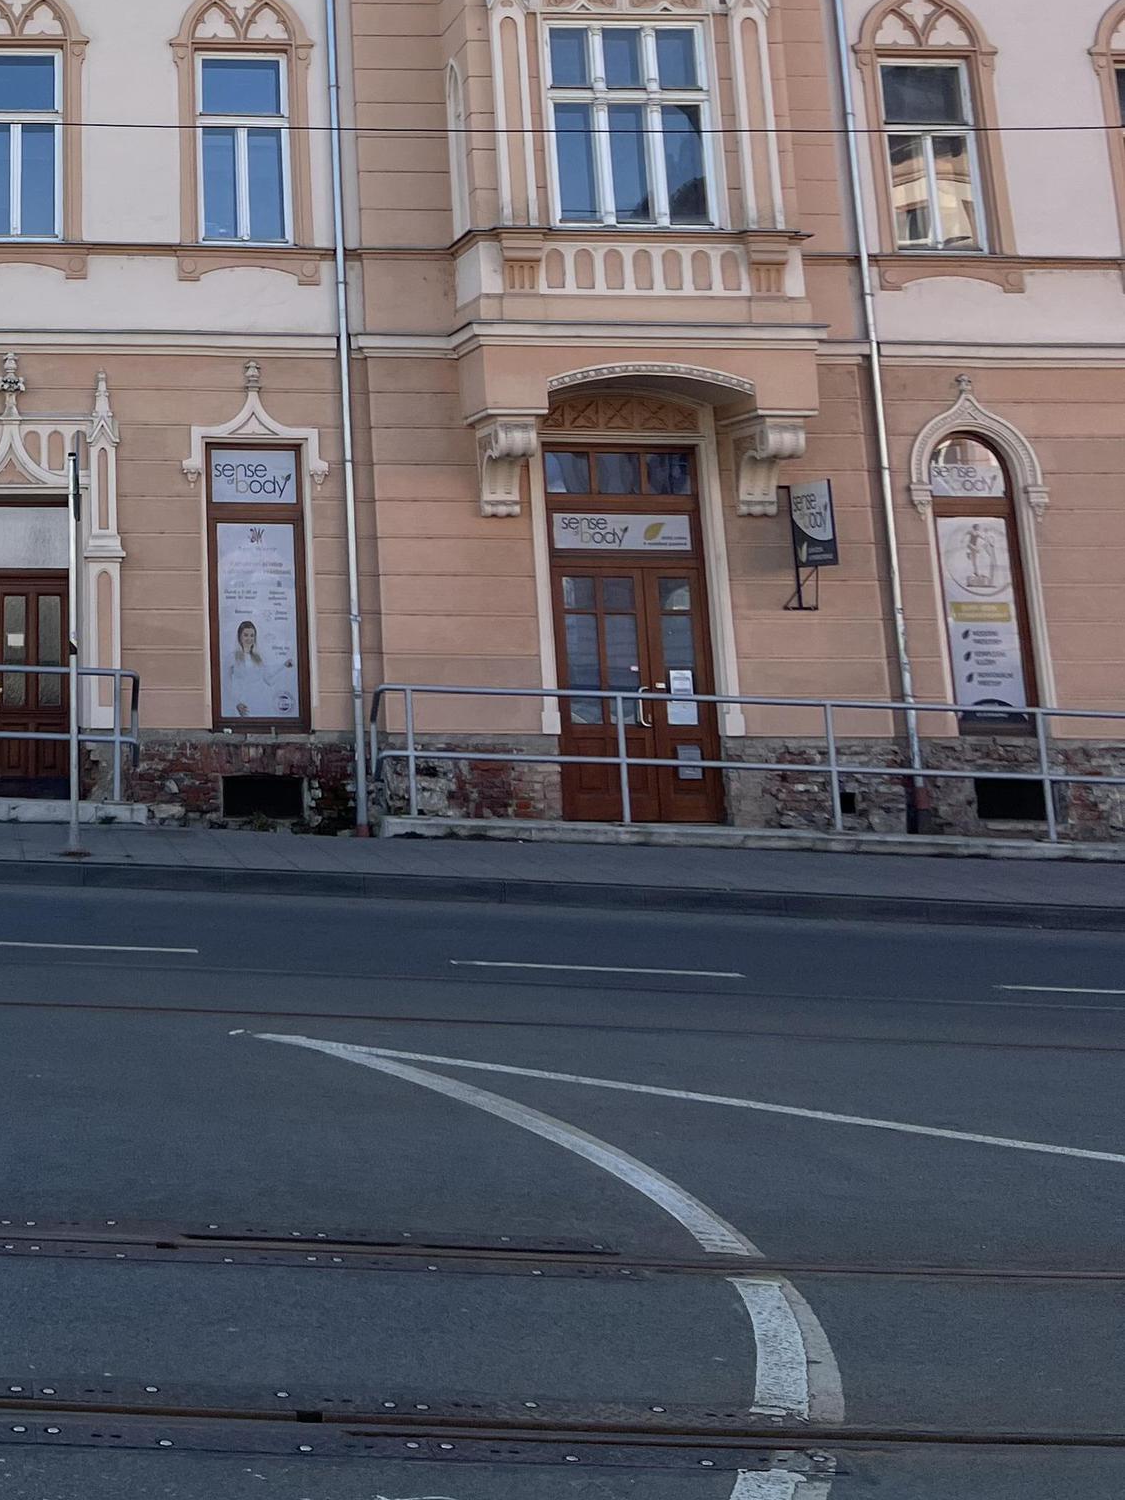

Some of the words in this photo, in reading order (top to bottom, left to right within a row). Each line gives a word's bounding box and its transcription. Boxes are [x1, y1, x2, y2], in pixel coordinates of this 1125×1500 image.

[214, 463, 267, 478] sense
[932, 466, 977, 478] sense
[236, 475, 291, 498] body
[561, 517, 608, 530] sense
[581, 527, 629, 548] body
